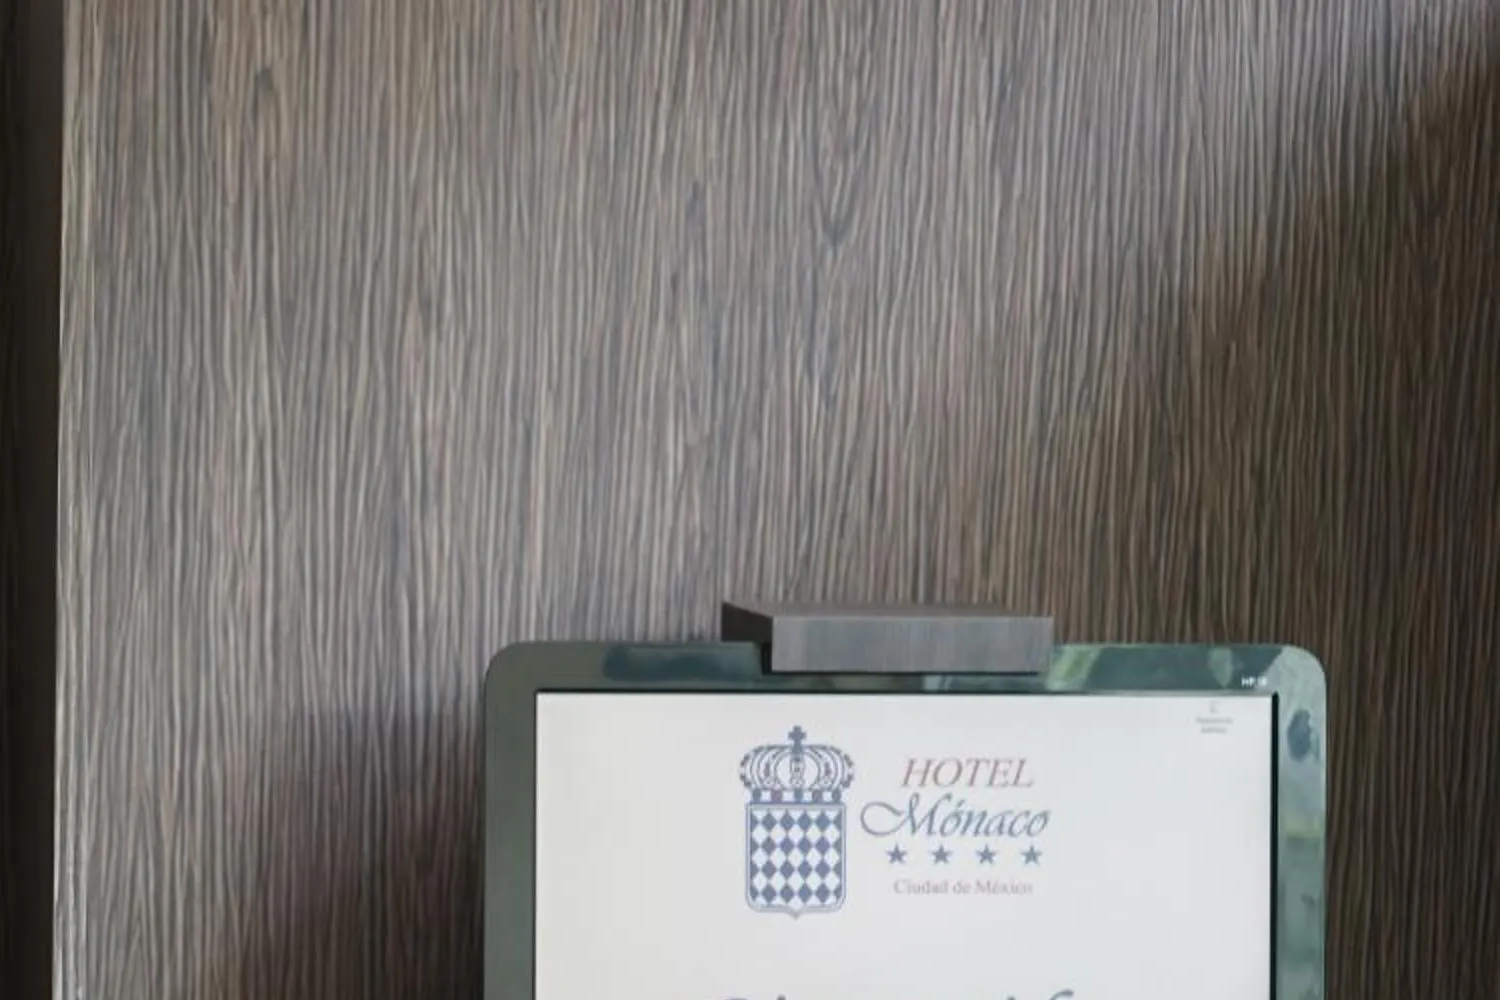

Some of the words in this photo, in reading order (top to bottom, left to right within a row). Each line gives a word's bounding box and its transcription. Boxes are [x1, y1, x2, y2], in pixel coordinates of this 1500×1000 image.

[901, 757, 1034, 788] HOTEL
[860, 792, 1052, 838] Mónaco
[893, 878, 949, 895] Ciudad
[952, 878, 970, 895] de
